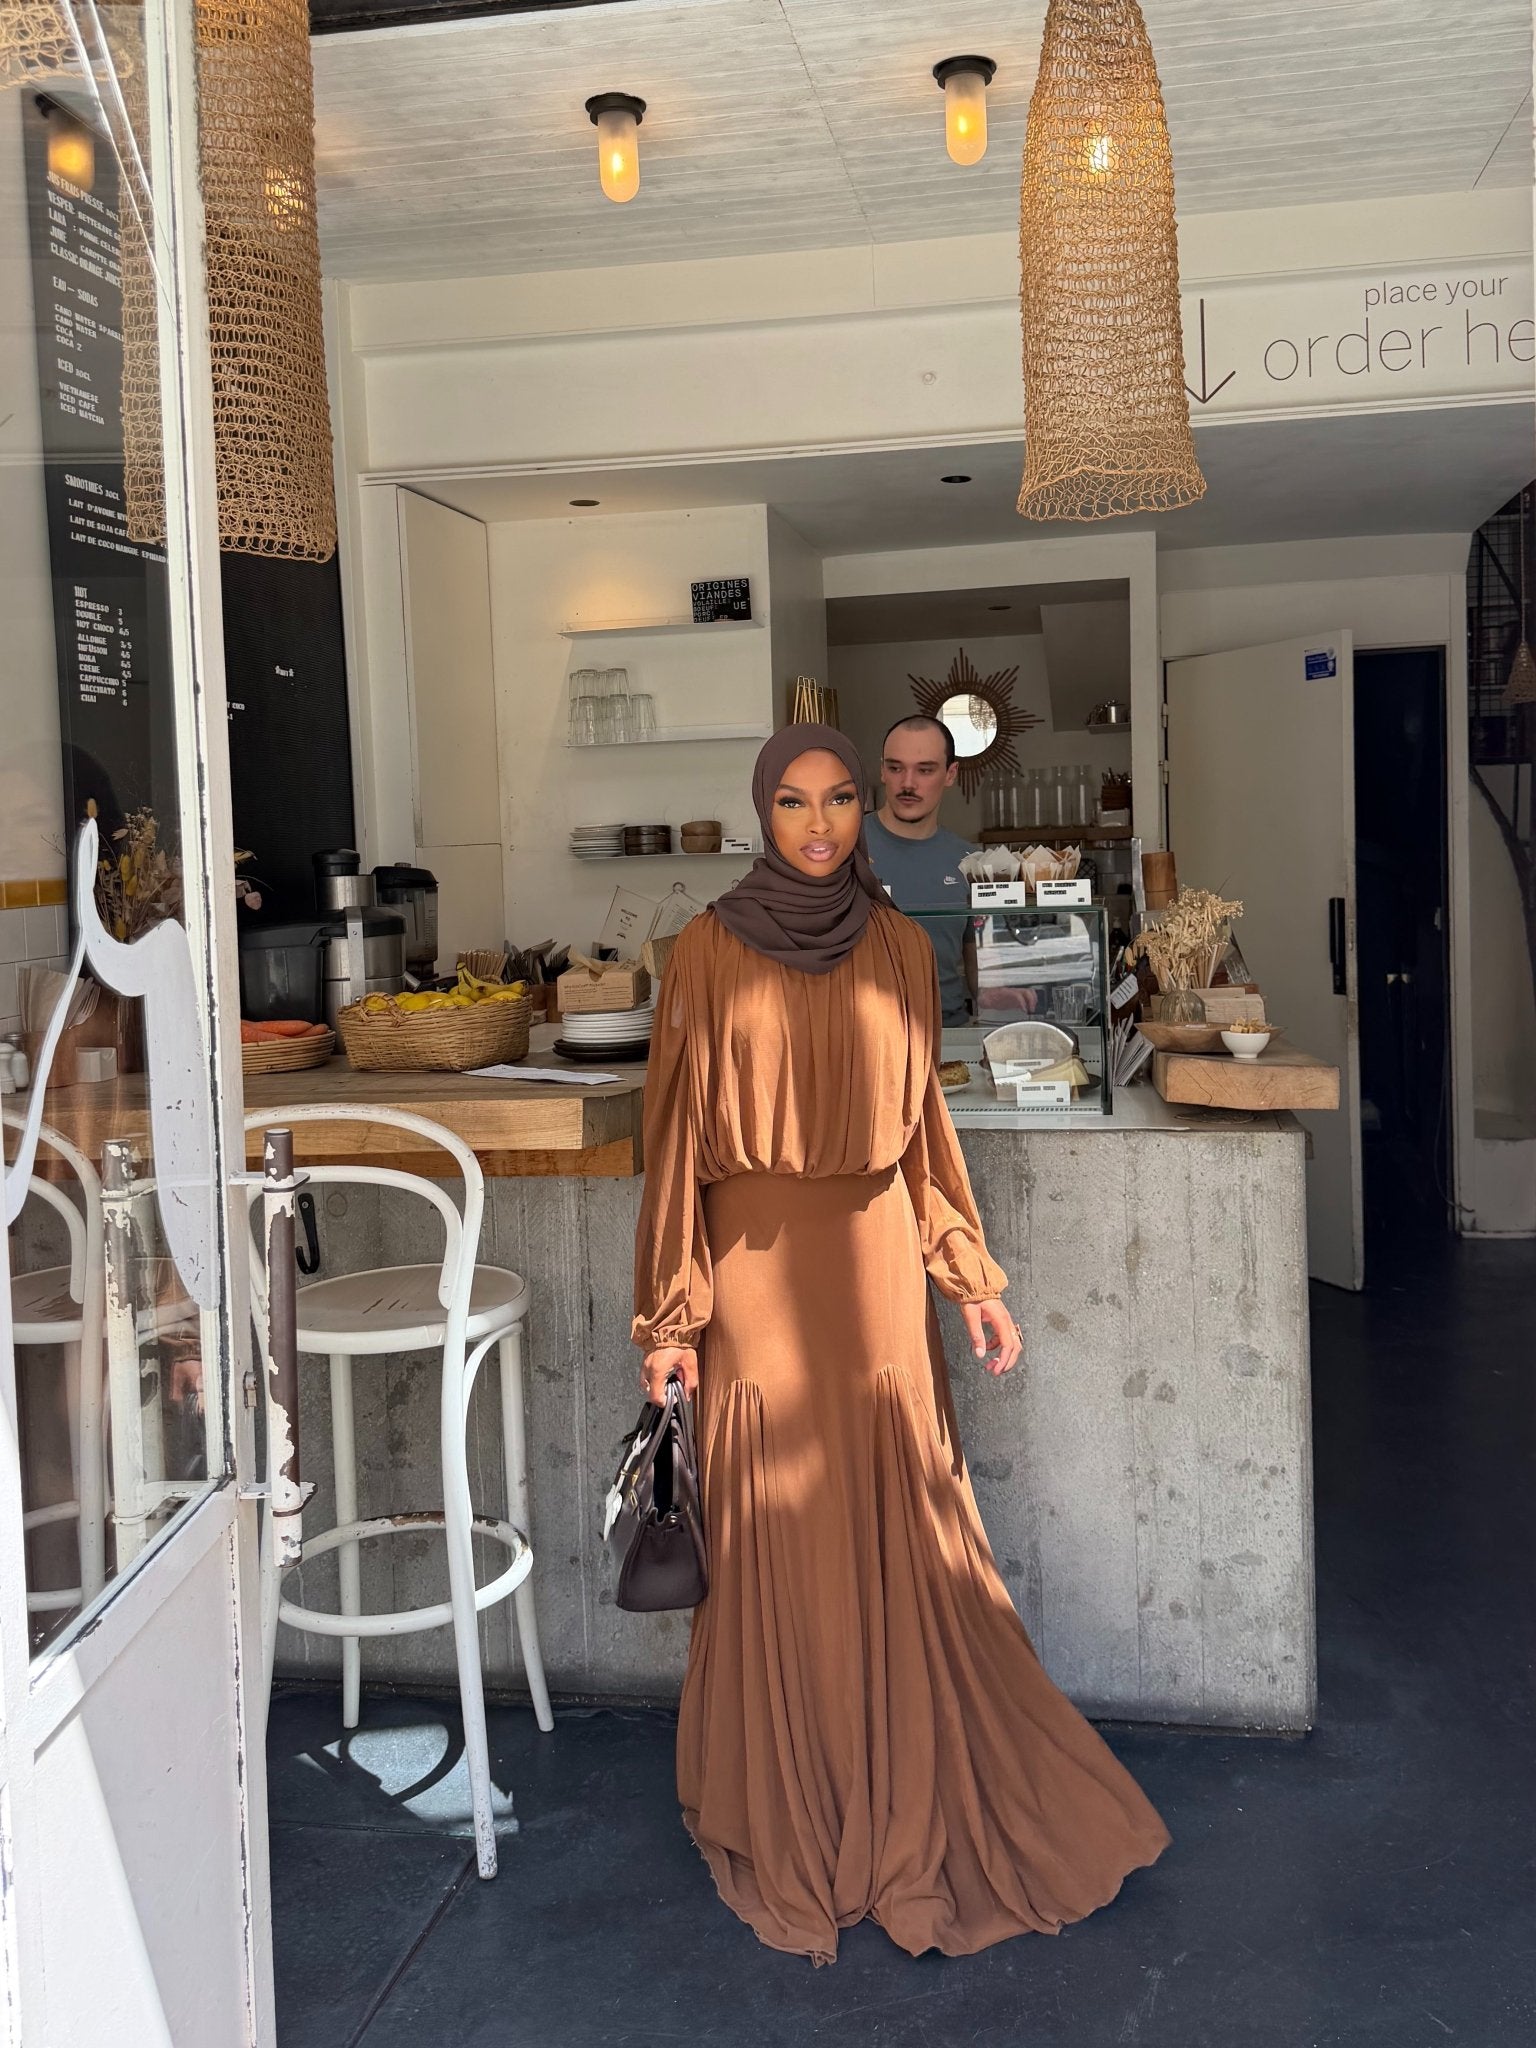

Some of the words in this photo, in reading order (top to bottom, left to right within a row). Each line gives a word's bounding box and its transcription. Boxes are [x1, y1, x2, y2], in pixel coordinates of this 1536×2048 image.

[50, 242, 79, 265] CLASSIC
[79, 257, 104, 279] ORANGE
[77, 288, 99, 307] SODAS
[1364, 280, 1438, 312] place
[1445, 275, 1509, 306] your
[75, 312, 96, 329] WATER
[56, 324, 74, 338] COCA
[75, 322, 97, 339] WATER
[56, 334, 74, 349] COCA
[1264, 316, 1443, 381] order
[57, 358, 74, 374] ICED
[59, 392, 75, 404] ICED
[78, 399, 96, 412] CAFE
[60, 402, 76, 415] ICED
[79, 409, 105, 425] MATCHA
[68, 498, 84, 509] LAIT
[69, 515, 86, 526] LAIT
[86, 519, 96, 529] DE
[96, 522, 114, 534] SOJA
[71, 531, 86, 543] LAIT
[87, 535, 97, 546] DE
[98, 539, 115, 550] COCO
[74, 586, 88, 599] HOT
[692, 580, 747, 592] ORIGINES
[693, 589, 742, 601] VIANDES
[75, 600, 109, 613] ESPRESSO
[733, 601, 747, 610] UE
[76, 610, 102, 621] DOUBLE
[76, 620, 90, 629] HOT
[93, 623, 114, 634] CHOCO
[78, 633, 107, 645] ALLONGE
[80, 674, 120, 686] CAPPUCCINO
[80, 684, 116, 696] MACCHIATO
[81, 694, 97, 703] CHAI
